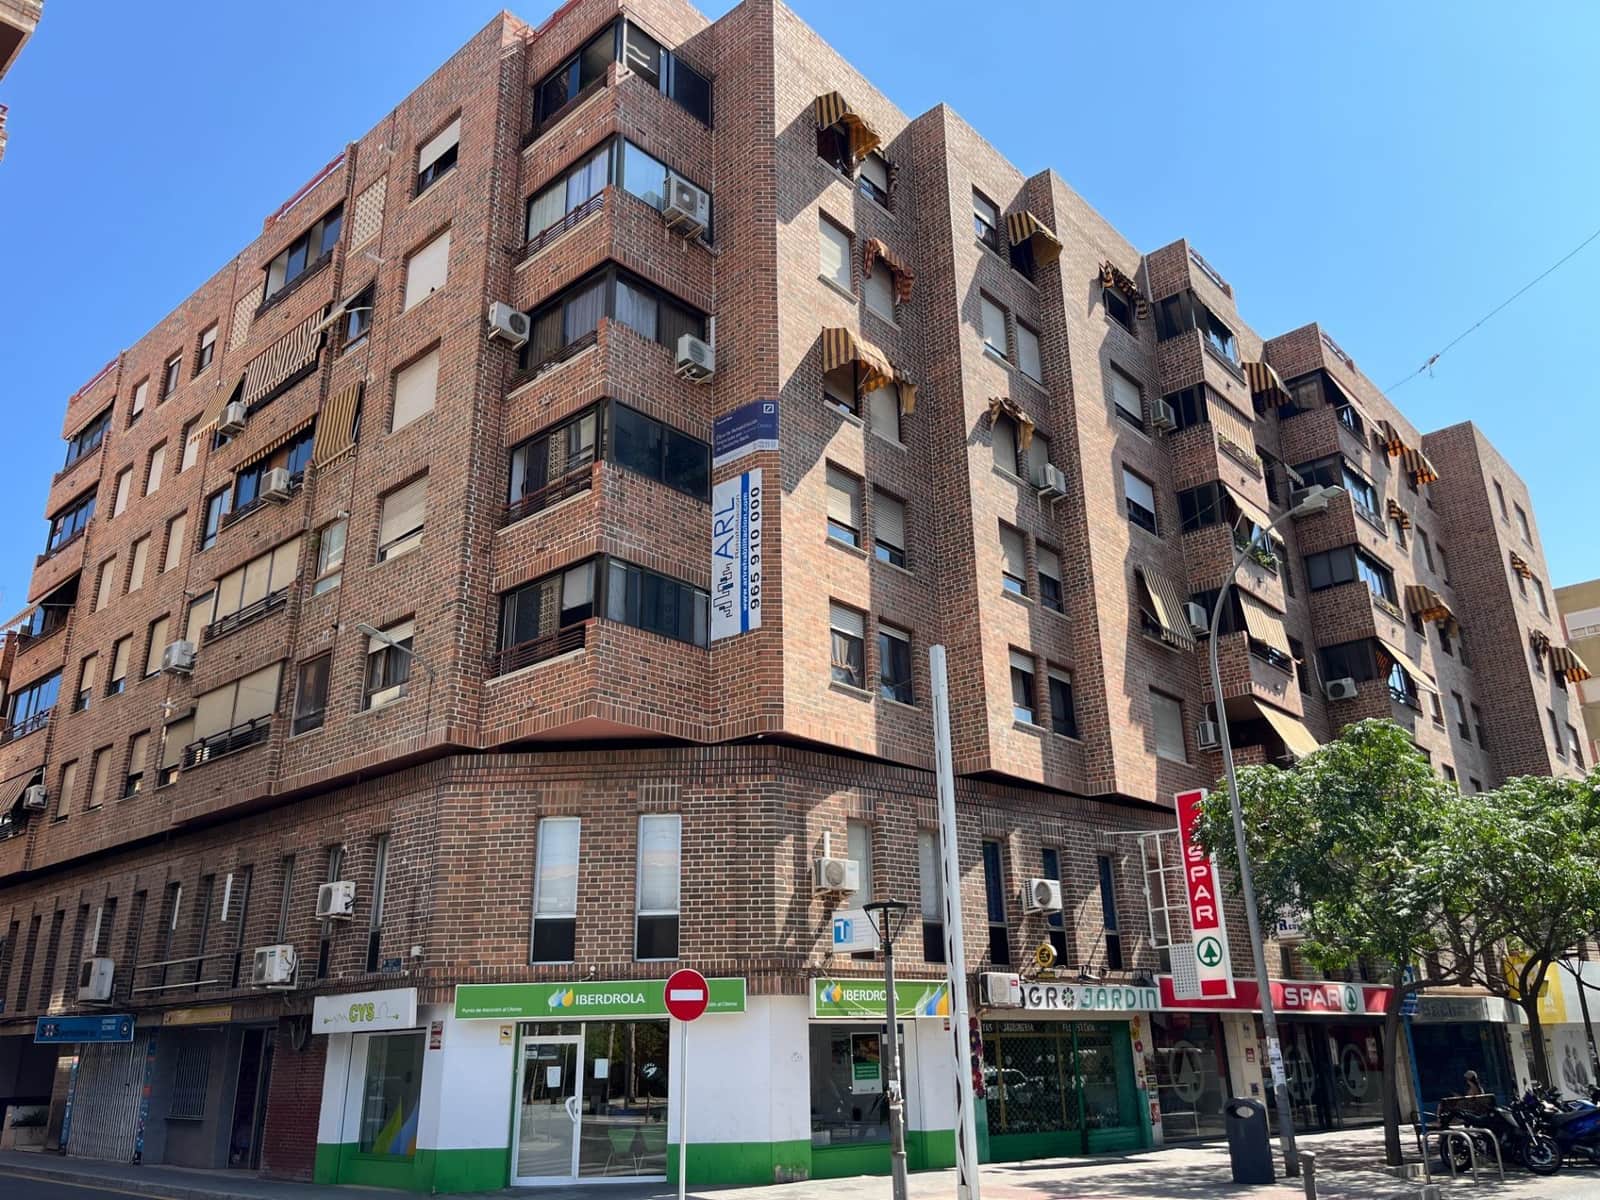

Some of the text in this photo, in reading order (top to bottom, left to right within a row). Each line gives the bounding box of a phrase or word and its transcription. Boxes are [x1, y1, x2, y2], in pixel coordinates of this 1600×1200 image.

[713, 497, 735, 559] ARL
[750, 486, 760, 610] 965 910 000
[1187, 845, 1214, 922] SPAR
[575, 992, 646, 1005] IBERDROLA
[843, 988, 900, 1001] IBERDROA
[1285, 987, 1341, 1007] SPAR
